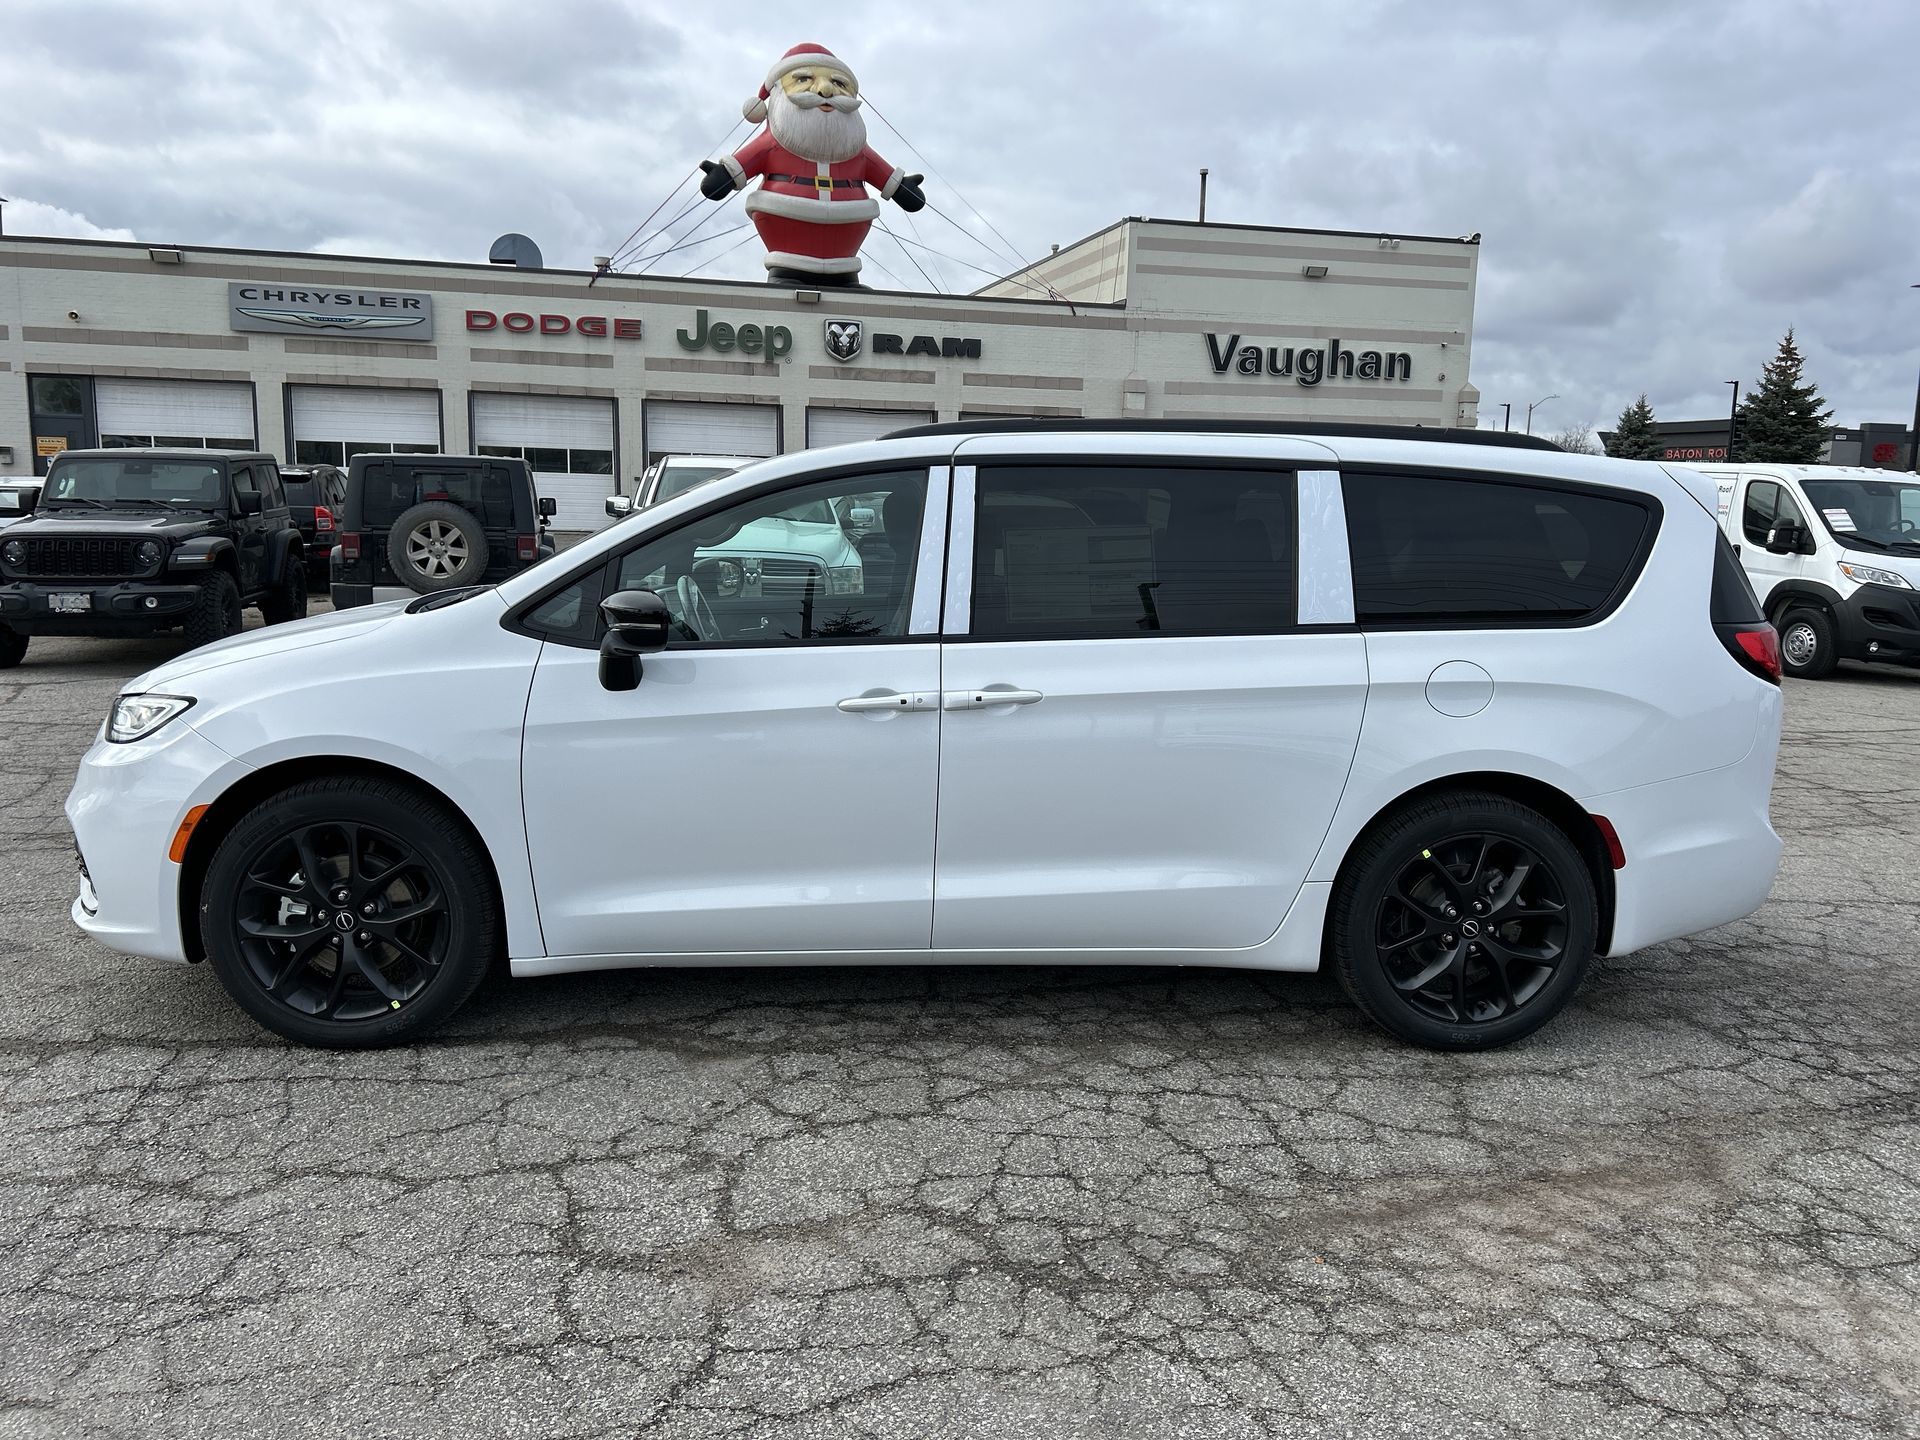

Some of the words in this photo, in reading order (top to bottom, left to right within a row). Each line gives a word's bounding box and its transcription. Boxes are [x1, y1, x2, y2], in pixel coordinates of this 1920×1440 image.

[239, 288, 421, 310] CHRYSLER
[465, 310, 642, 340] DODGE
[676, 309, 793, 363] Jeep
[872, 333, 982, 359] RAM
[1202, 332, 1412, 387] Vaughan
